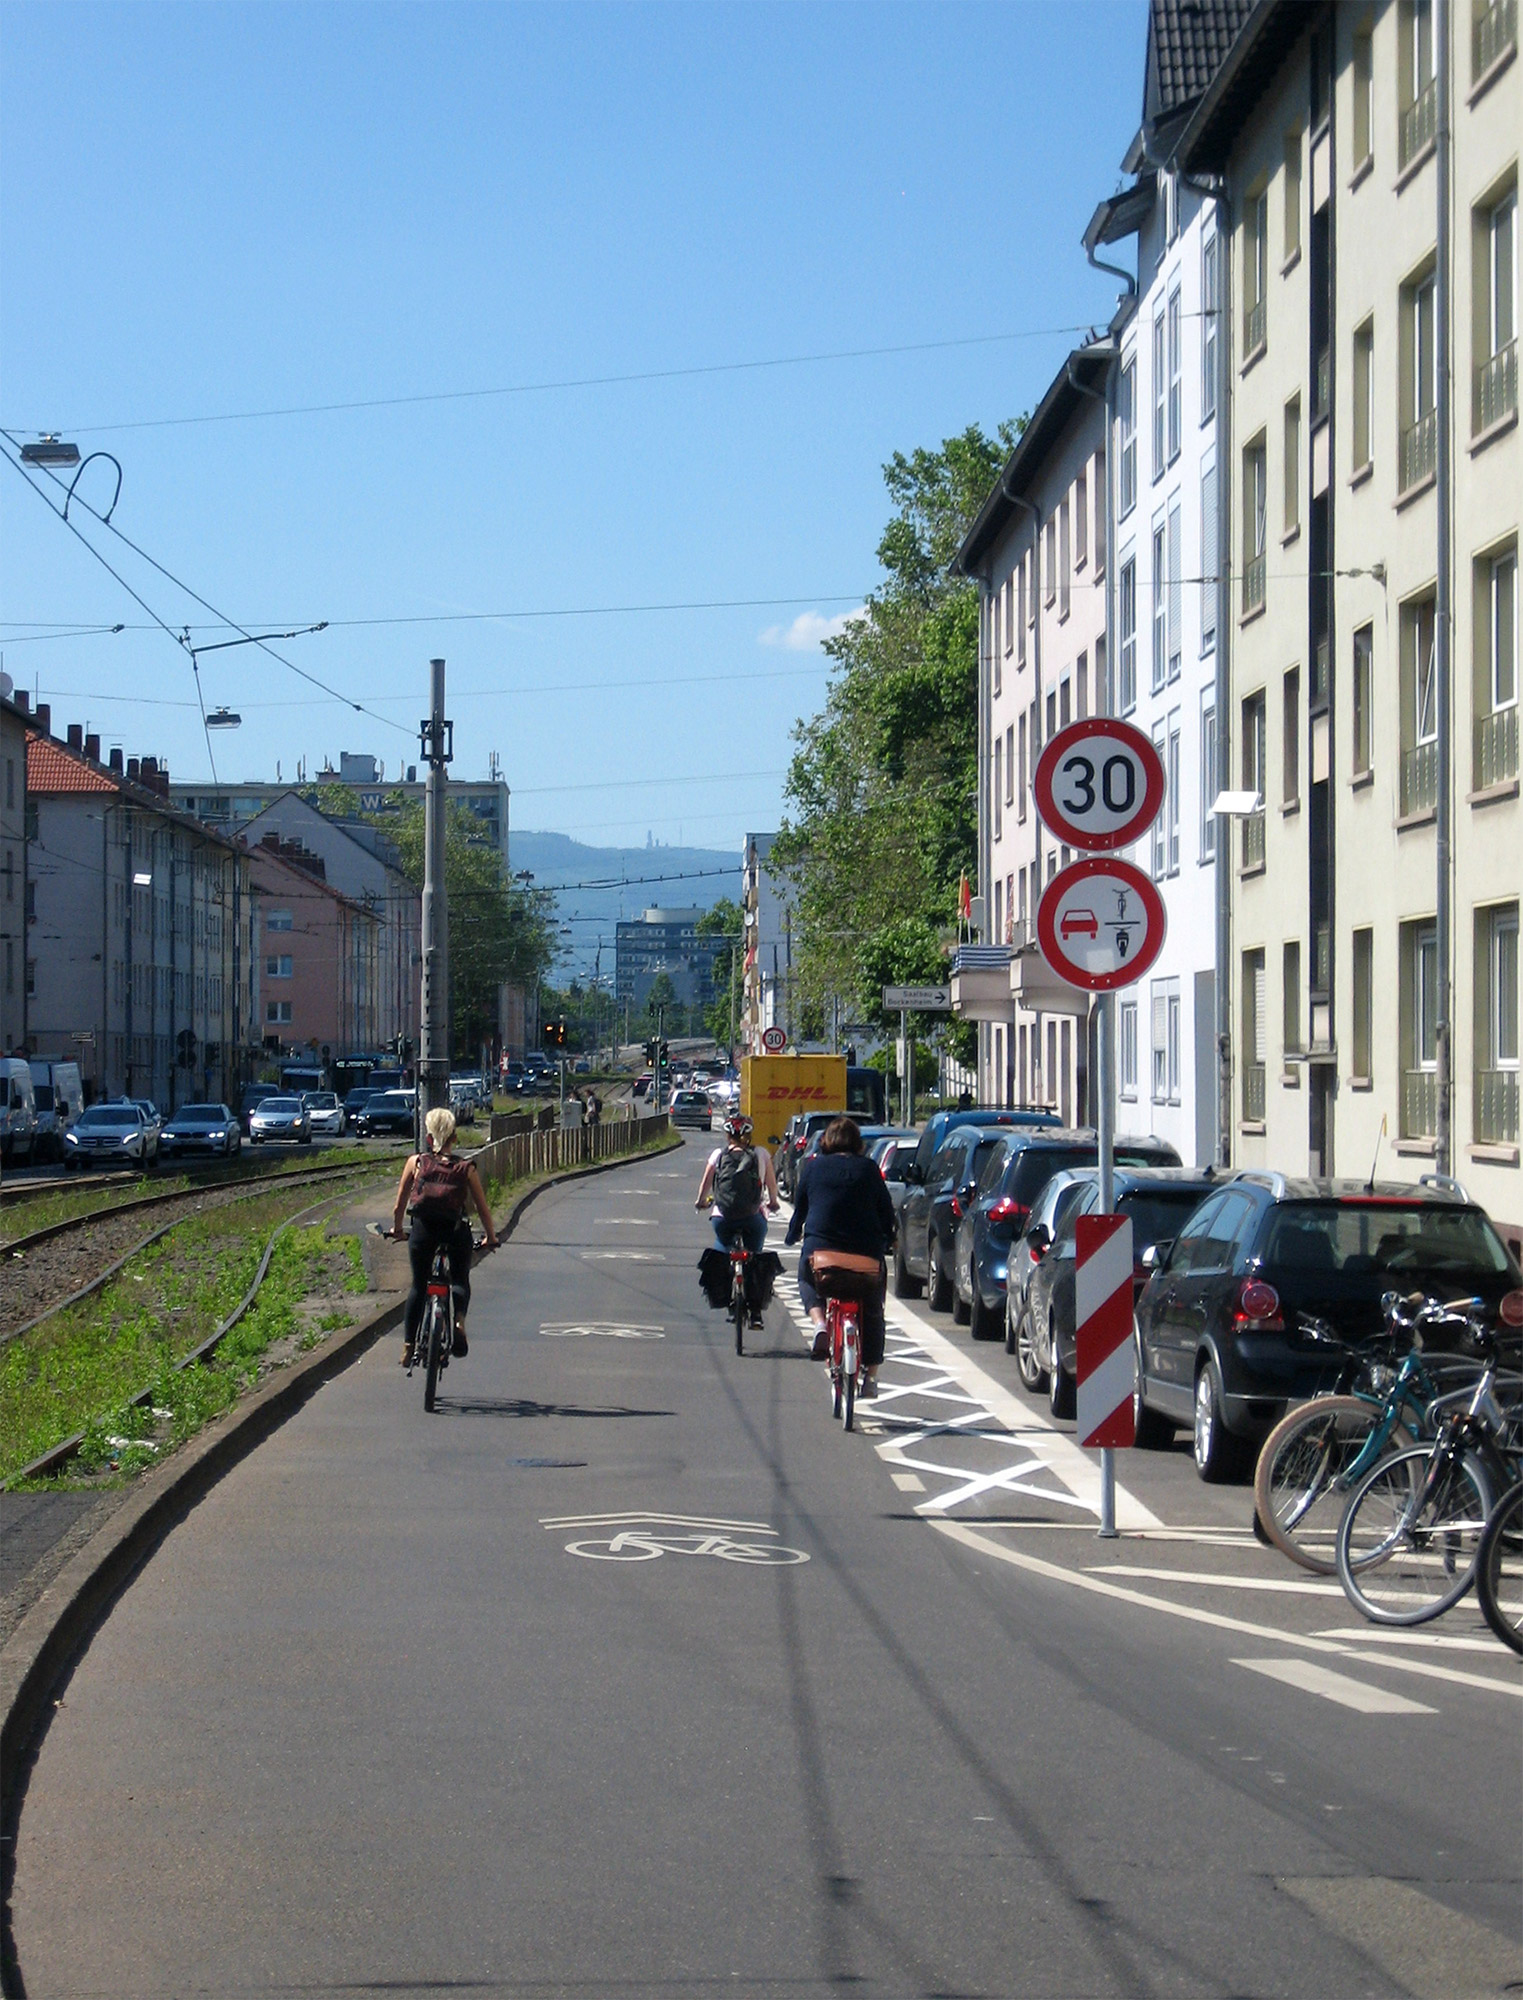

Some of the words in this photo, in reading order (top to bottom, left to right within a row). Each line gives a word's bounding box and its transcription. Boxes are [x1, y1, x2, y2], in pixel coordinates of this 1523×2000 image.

[1062, 754, 1136, 815] 30
[903, 990, 933, 998] Saalbau
[767, 1033, 782, 1045] 30
[767, 1086, 828, 1099] DHL
